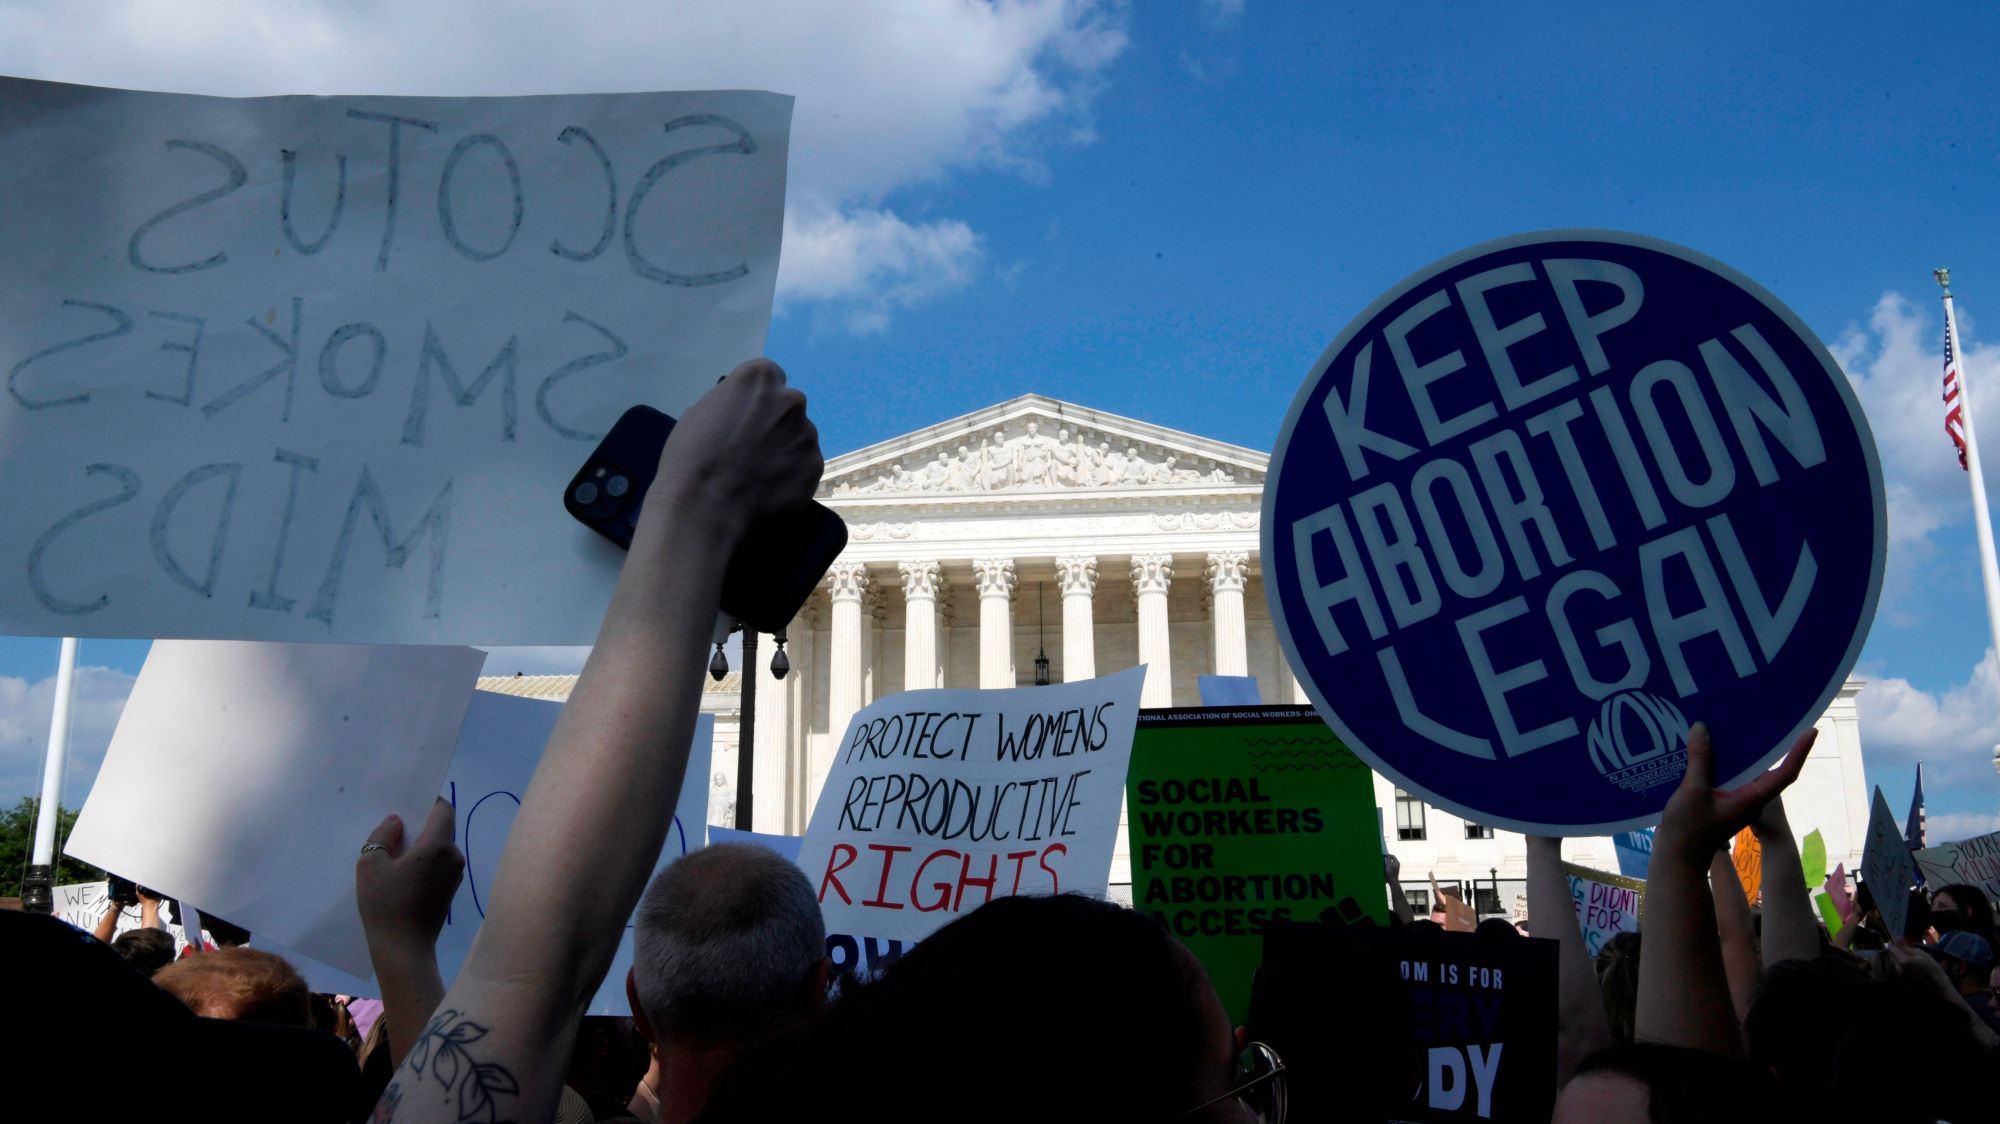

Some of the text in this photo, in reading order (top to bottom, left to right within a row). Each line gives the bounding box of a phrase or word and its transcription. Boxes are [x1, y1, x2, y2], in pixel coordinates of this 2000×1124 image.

[1322, 258, 1646, 482] KEEP
[1292, 323, 1827, 657] ABORTION
[1376, 512, 1818, 762] LEGAL
[846, 702, 1114, 765] PROTECT WOMENS
[1168, 712, 1220, 721] ASSOCIATION
[1221, 712, 1231, 720] OF
[1232, 711, 1261, 720] SOCIAL
[1587, 690, 1690, 776] NOW
[838, 770, 1092, 842] REPRODUCTIVE
[1138, 777, 1271, 806] SOCIAL
[1140, 807, 1325, 838] WORKERS
[818, 843, 1068, 913] RIGHTS
[1142, 843, 1216, 871] FOR
[63, 885, 95, 906] WE
[1145, 873, 1335, 905] ABORTION
[1586, 905, 1623, 932] FOR
[1440, 963, 1459, 985] IS
[1469, 966, 1503, 990] FOR
[1428, 1042, 1504, 1119] DY
